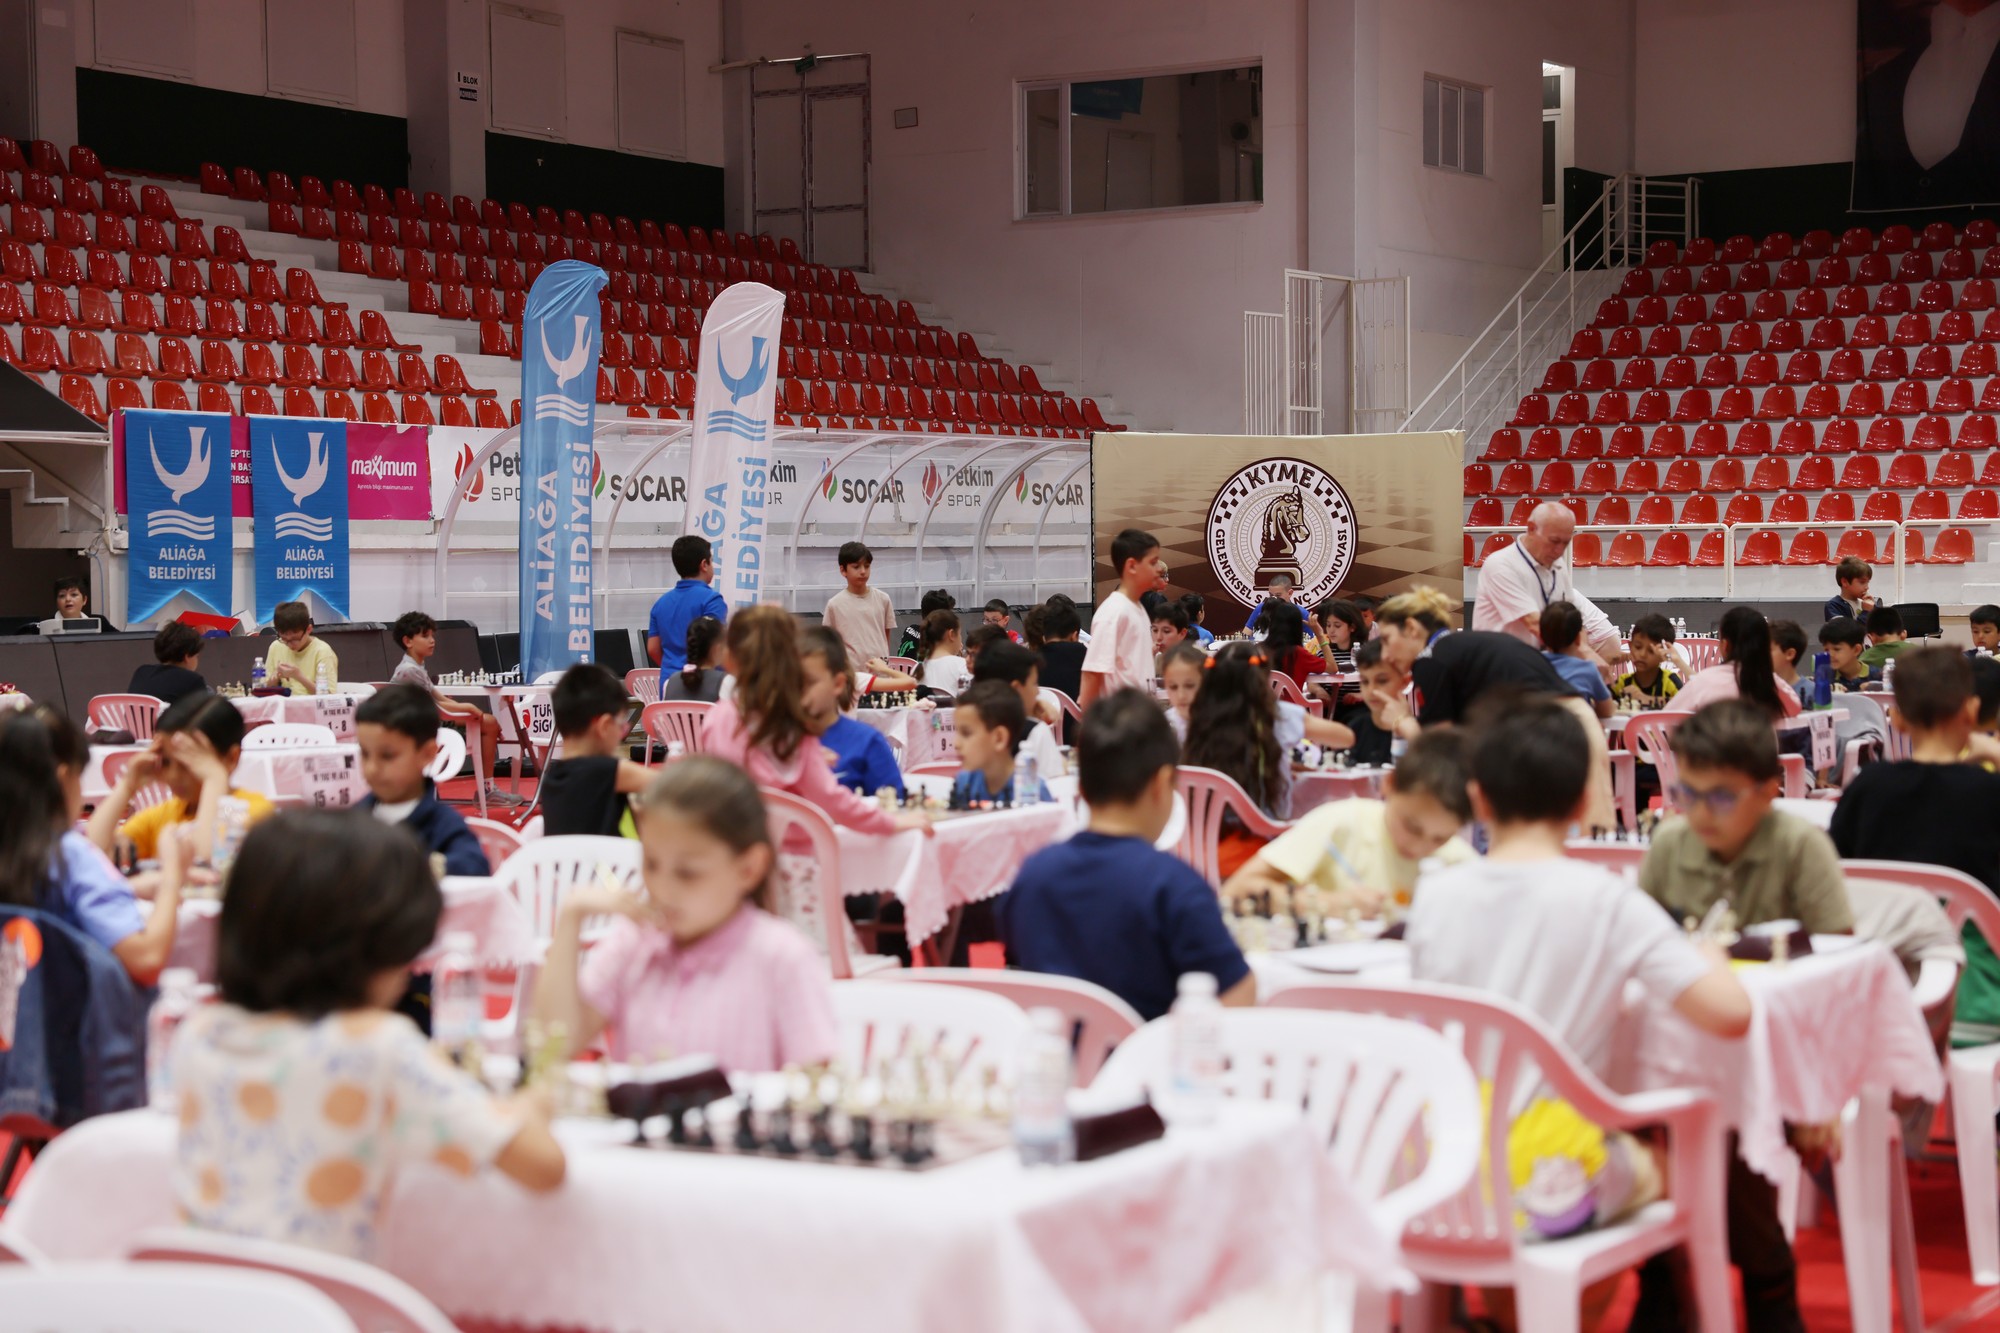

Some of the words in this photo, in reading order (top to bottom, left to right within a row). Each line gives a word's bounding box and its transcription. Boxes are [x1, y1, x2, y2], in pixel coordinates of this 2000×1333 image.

[462, 75, 479, 86] BLOK
[351, 454, 417, 481] maximum
[490, 451, 521, 477] Pet
[770, 459, 797, 483] kim
[1244, 462, 1316, 490] KYME
[610, 474, 688, 502] SOCAR
[841, 477, 905, 504] SOCAR
[947, 494, 982, 508] SPOR
[1031, 482, 1085, 506] SOCAR
[731, 456, 767, 608] LEDİYESİ
[158, 543, 206, 562] ALİAĞA
[284, 544, 325, 562] ALİAĞA
[528, 469, 558, 622] ALİAĞA
[563, 441, 592, 652] BELEDİYESİ
[148, 562, 216, 581] BELEDİYESİ
[276, 562, 334, 580] BELEDİYESİ
[1215, 528, 1253, 601] GELENEKSEL
[1310, 529, 1348, 598] TURNUVASI
